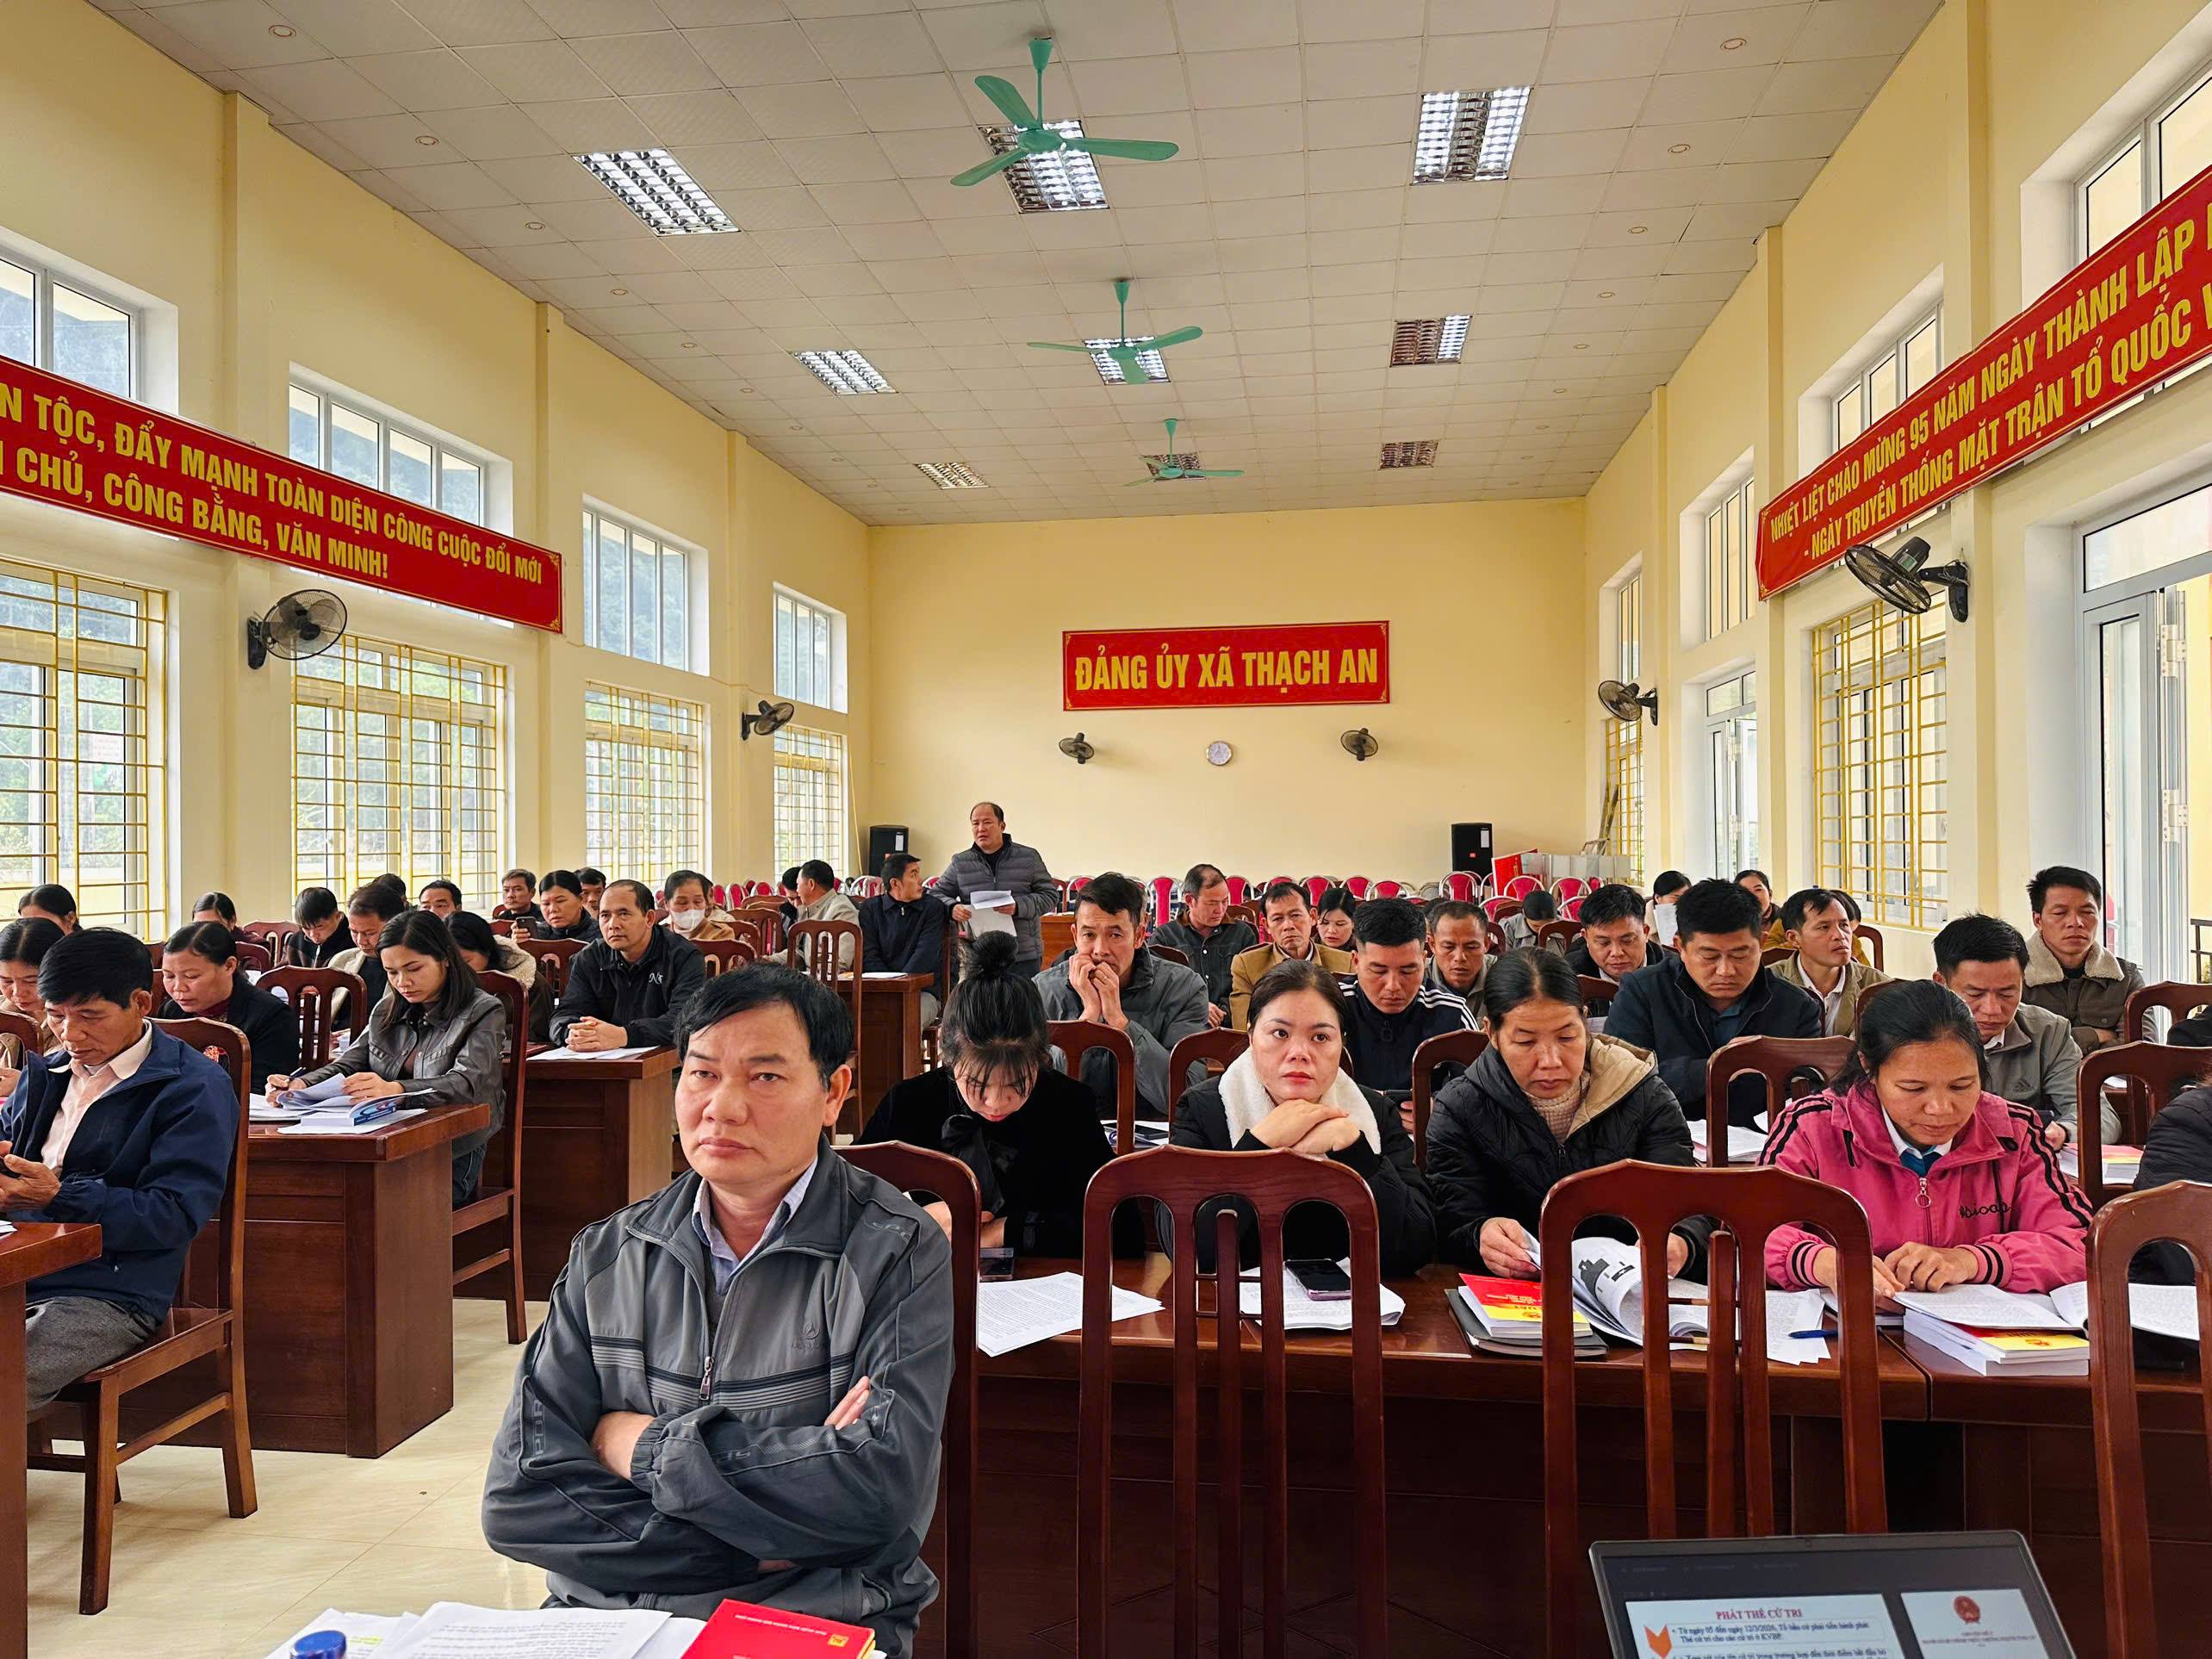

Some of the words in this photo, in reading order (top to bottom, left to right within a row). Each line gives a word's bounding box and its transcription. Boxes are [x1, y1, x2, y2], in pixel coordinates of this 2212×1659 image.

[1770, 505, 1799, 544] NHIỆT
[1801, 483, 1824, 524] LIỆT
[1827, 459, 1861, 506] CHÀO
[1863, 426, 1905, 483] MỪNG
[1909, 410, 1929, 451] 95
[1933, 376, 1975, 433] NĂM
[1980, 331, 2037, 402] NGÀY
[2042, 264, 2128, 360] THÀNH
[2136, 219, 2196, 298] LẬP
[1811, 517, 1842, 560] NGÀY
[1845, 480, 1897, 540] TRUYỀN
[1900, 448, 1954, 508] THỐNG
[1958, 418, 2001, 474] MẶT
[2004, 376, 2064, 447] TRẬN
[2071, 335, 2103, 407] TỔ
[2111, 291, 2192, 386] QUỐC
[16, 447, 94, 503] CHỦ,
[103, 472, 183, 525] CÔNG
[192, 493, 270, 549] BẰNG,
[276, 522, 321, 561] VĂN
[328, 537, 388, 579] MINH!
[34, 394, 104, 453] TỘC,
[115, 419, 172, 469] ĐẨY
[181, 444, 258, 498] MẠNH
[265, 471, 324, 518] TOÀN
[330, 494, 377, 534] DIỆN
[383, 511, 433, 551] CÔNG
[438, 531, 481, 565] CUỘC
[486, 542, 511, 575] ĐỔI
[515, 556, 543, 584] MỚI
[1075, 644, 1147, 691] ĐẢNG
[1157, 643, 1190, 688] ỦY
[1198, 646, 1234, 687] XÃ
[1241, 649, 1330, 693] THẠCH
[1339, 648, 1378, 684] AN
[1784, 1608, 1803, 1618] TRI
